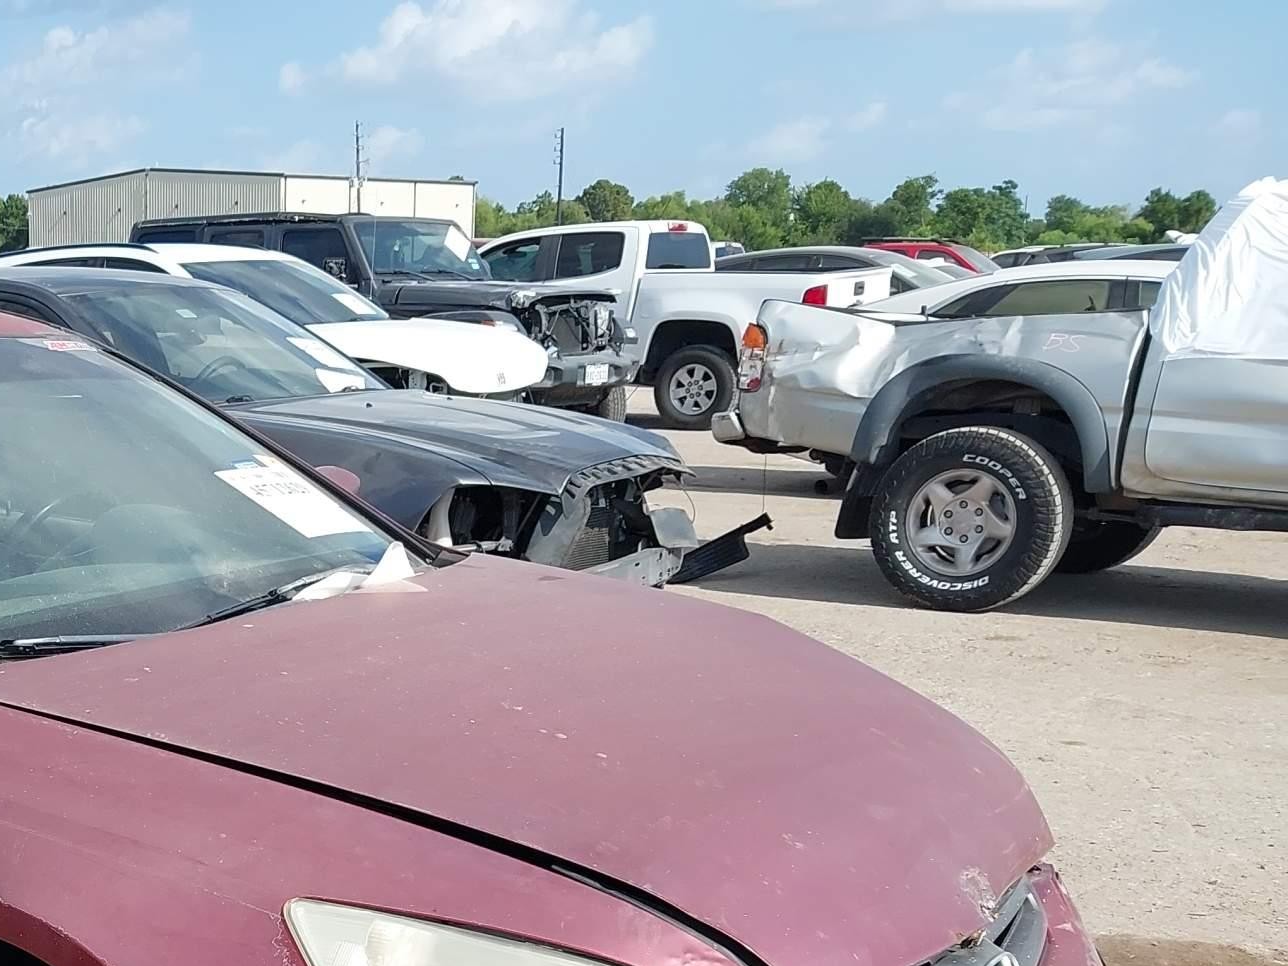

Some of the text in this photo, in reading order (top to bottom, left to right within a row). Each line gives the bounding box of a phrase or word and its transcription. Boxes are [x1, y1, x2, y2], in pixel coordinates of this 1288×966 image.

[962, 453, 1027, 500] COOPER
[888, 510, 990, 591] DISCOVERER ATP
